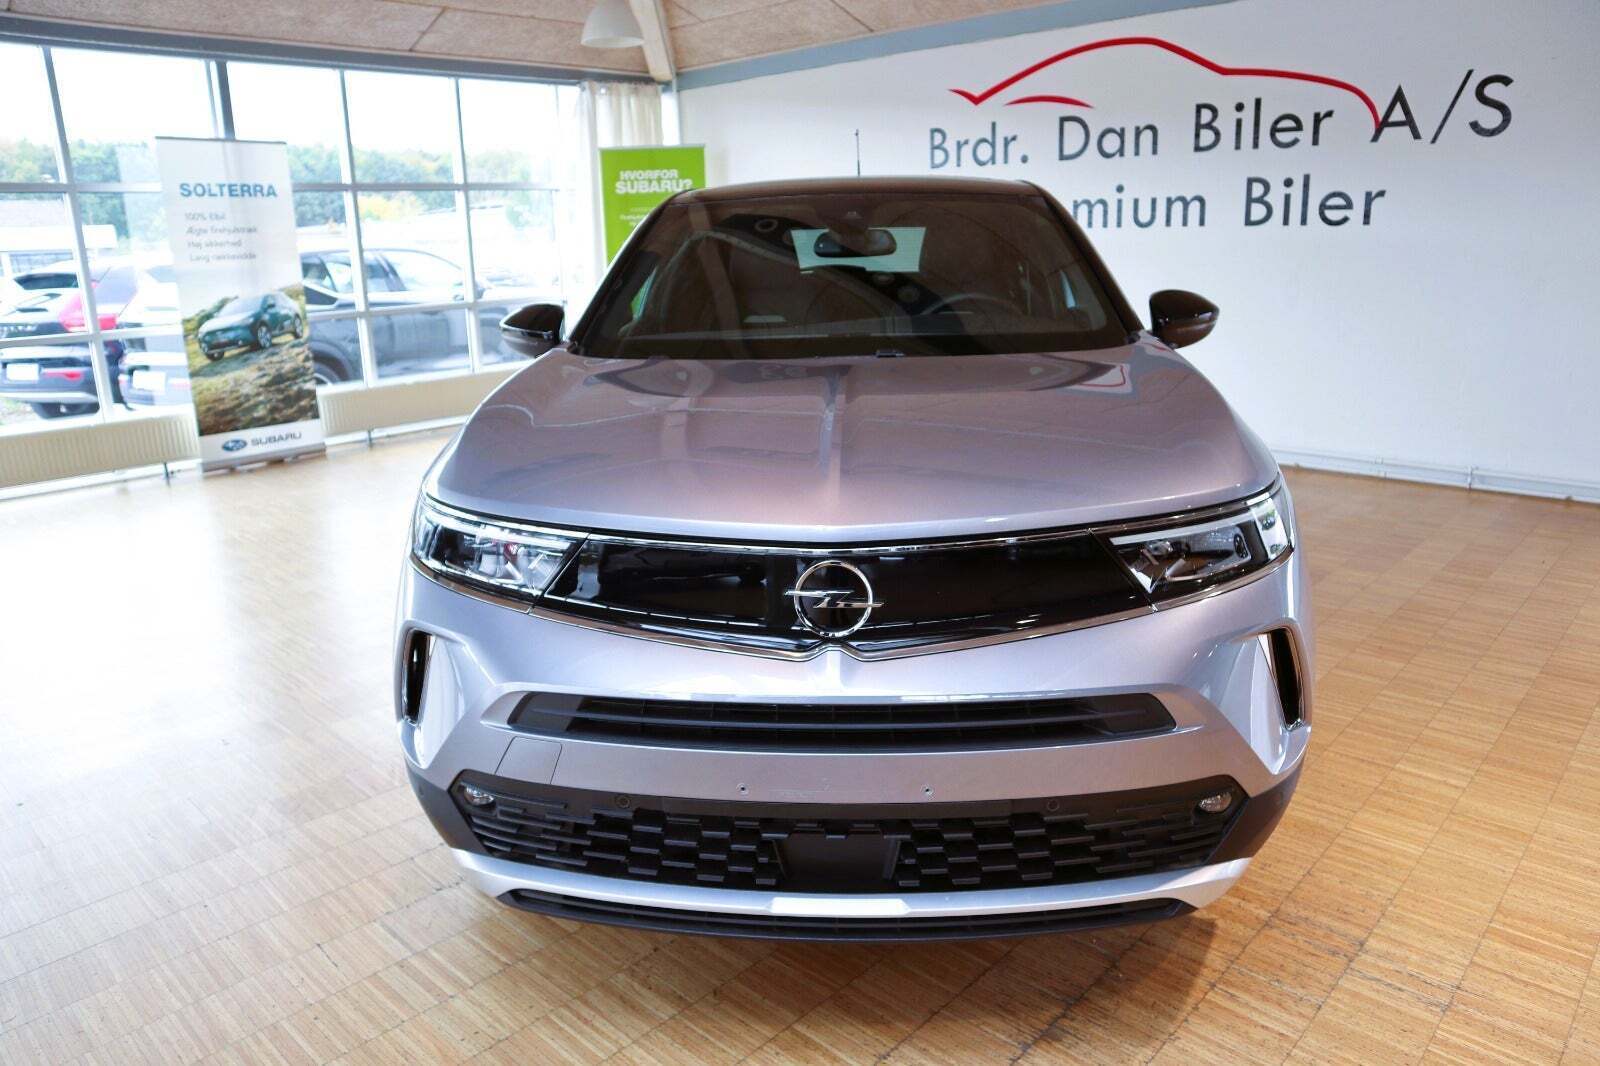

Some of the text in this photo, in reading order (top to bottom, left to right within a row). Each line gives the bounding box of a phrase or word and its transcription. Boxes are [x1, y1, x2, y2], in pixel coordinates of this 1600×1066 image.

[930, 68, 1515, 169] Brdr. Dan Biler A/S
[619, 169, 678, 180] HVORFOR
[179, 183, 278, 198] SOLTERRA
[615, 179, 693, 194] SUBARU?
[1072, 173, 1387, 229] mium Biler
[250, 432, 302, 446] SUBARU
